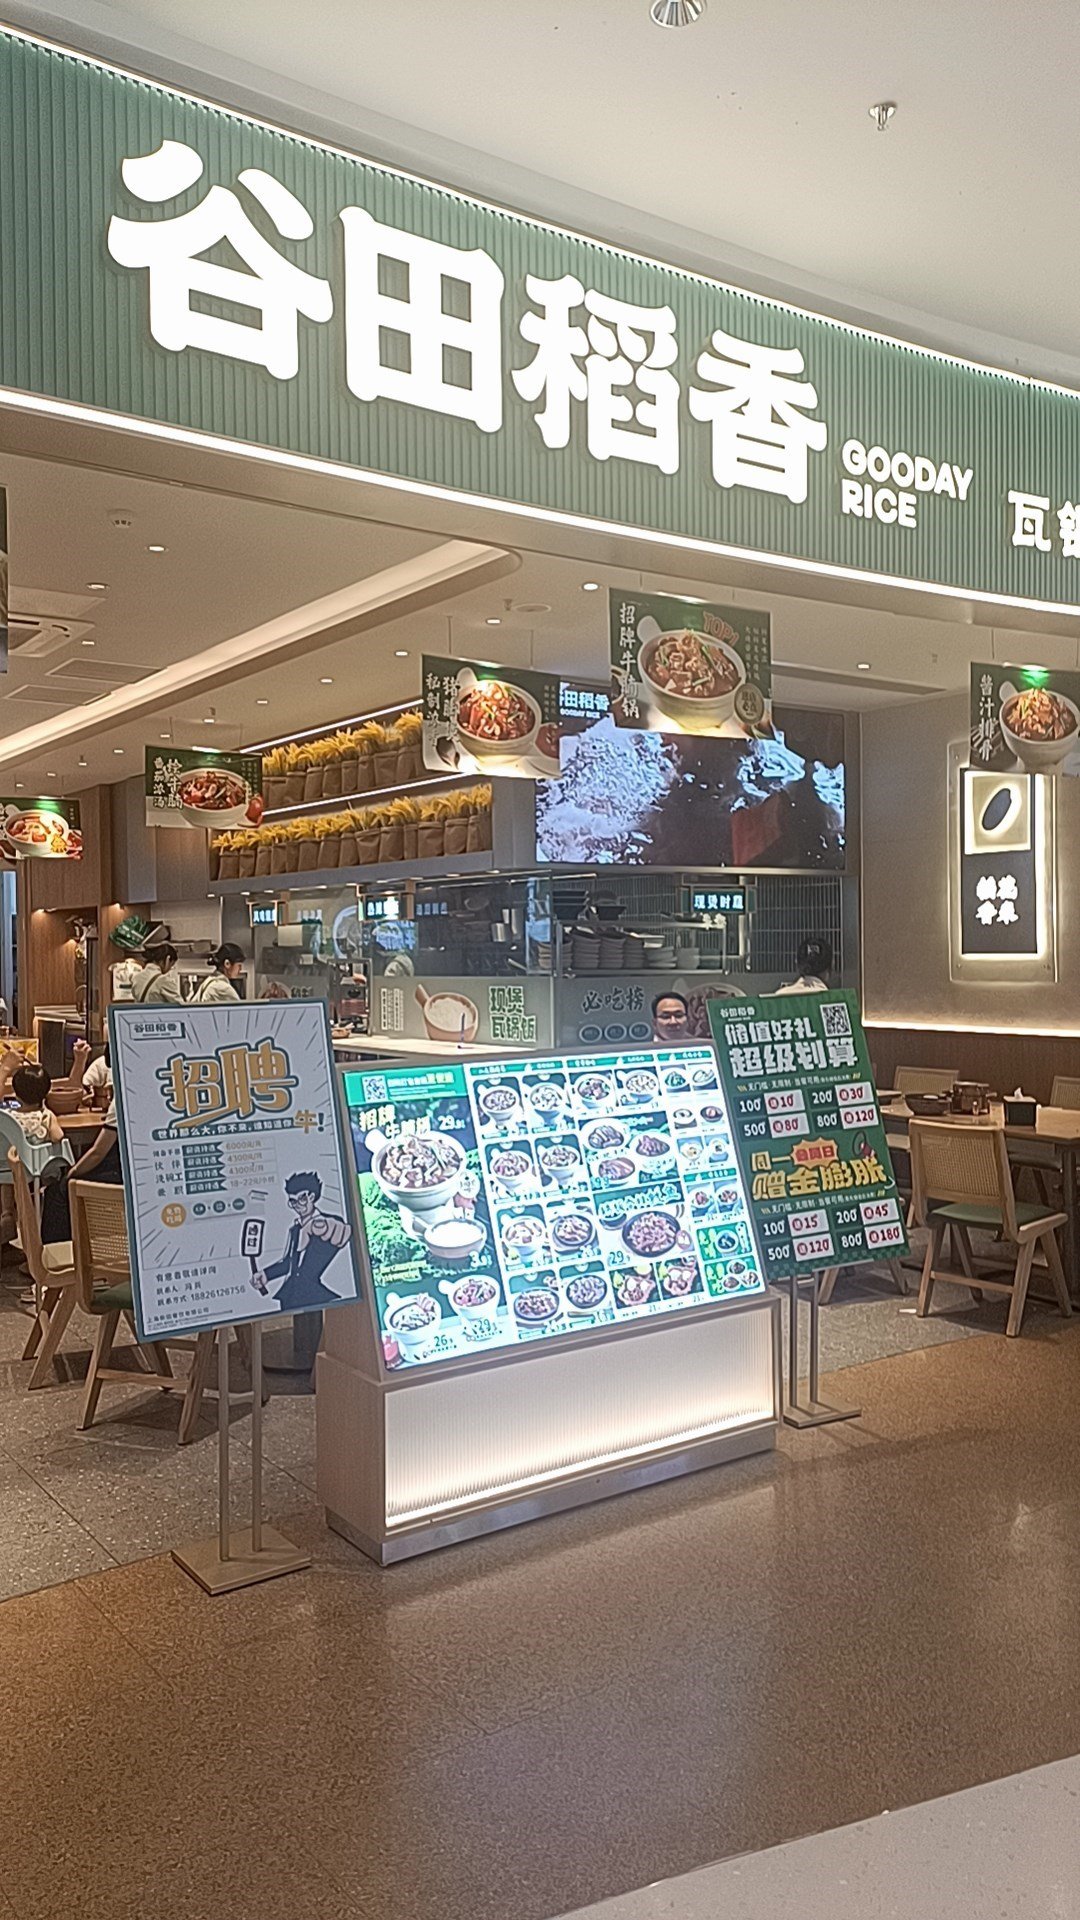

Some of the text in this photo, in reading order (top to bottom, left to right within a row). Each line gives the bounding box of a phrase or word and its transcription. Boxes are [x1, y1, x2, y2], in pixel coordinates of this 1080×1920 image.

[107, 139, 828, 503] 谷田稻香
[841, 439, 974, 501] GOODAY
[841, 477, 917, 528] RICE
[619, 602, 640, 719] 招牌牛腩锅
[560, 685, 610, 711] 田稻香
[582, 985, 645, 1014] 必吃榜
[490, 1014, 537, 1042] 瓦锅饭
[725, 1017, 817, 1045] 储值好礼
[729, 1037, 858, 1078] 超级划算
[156, 1037, 298, 1129] 招聘
[752, 1155, 887, 1200] 赠金膨胀
